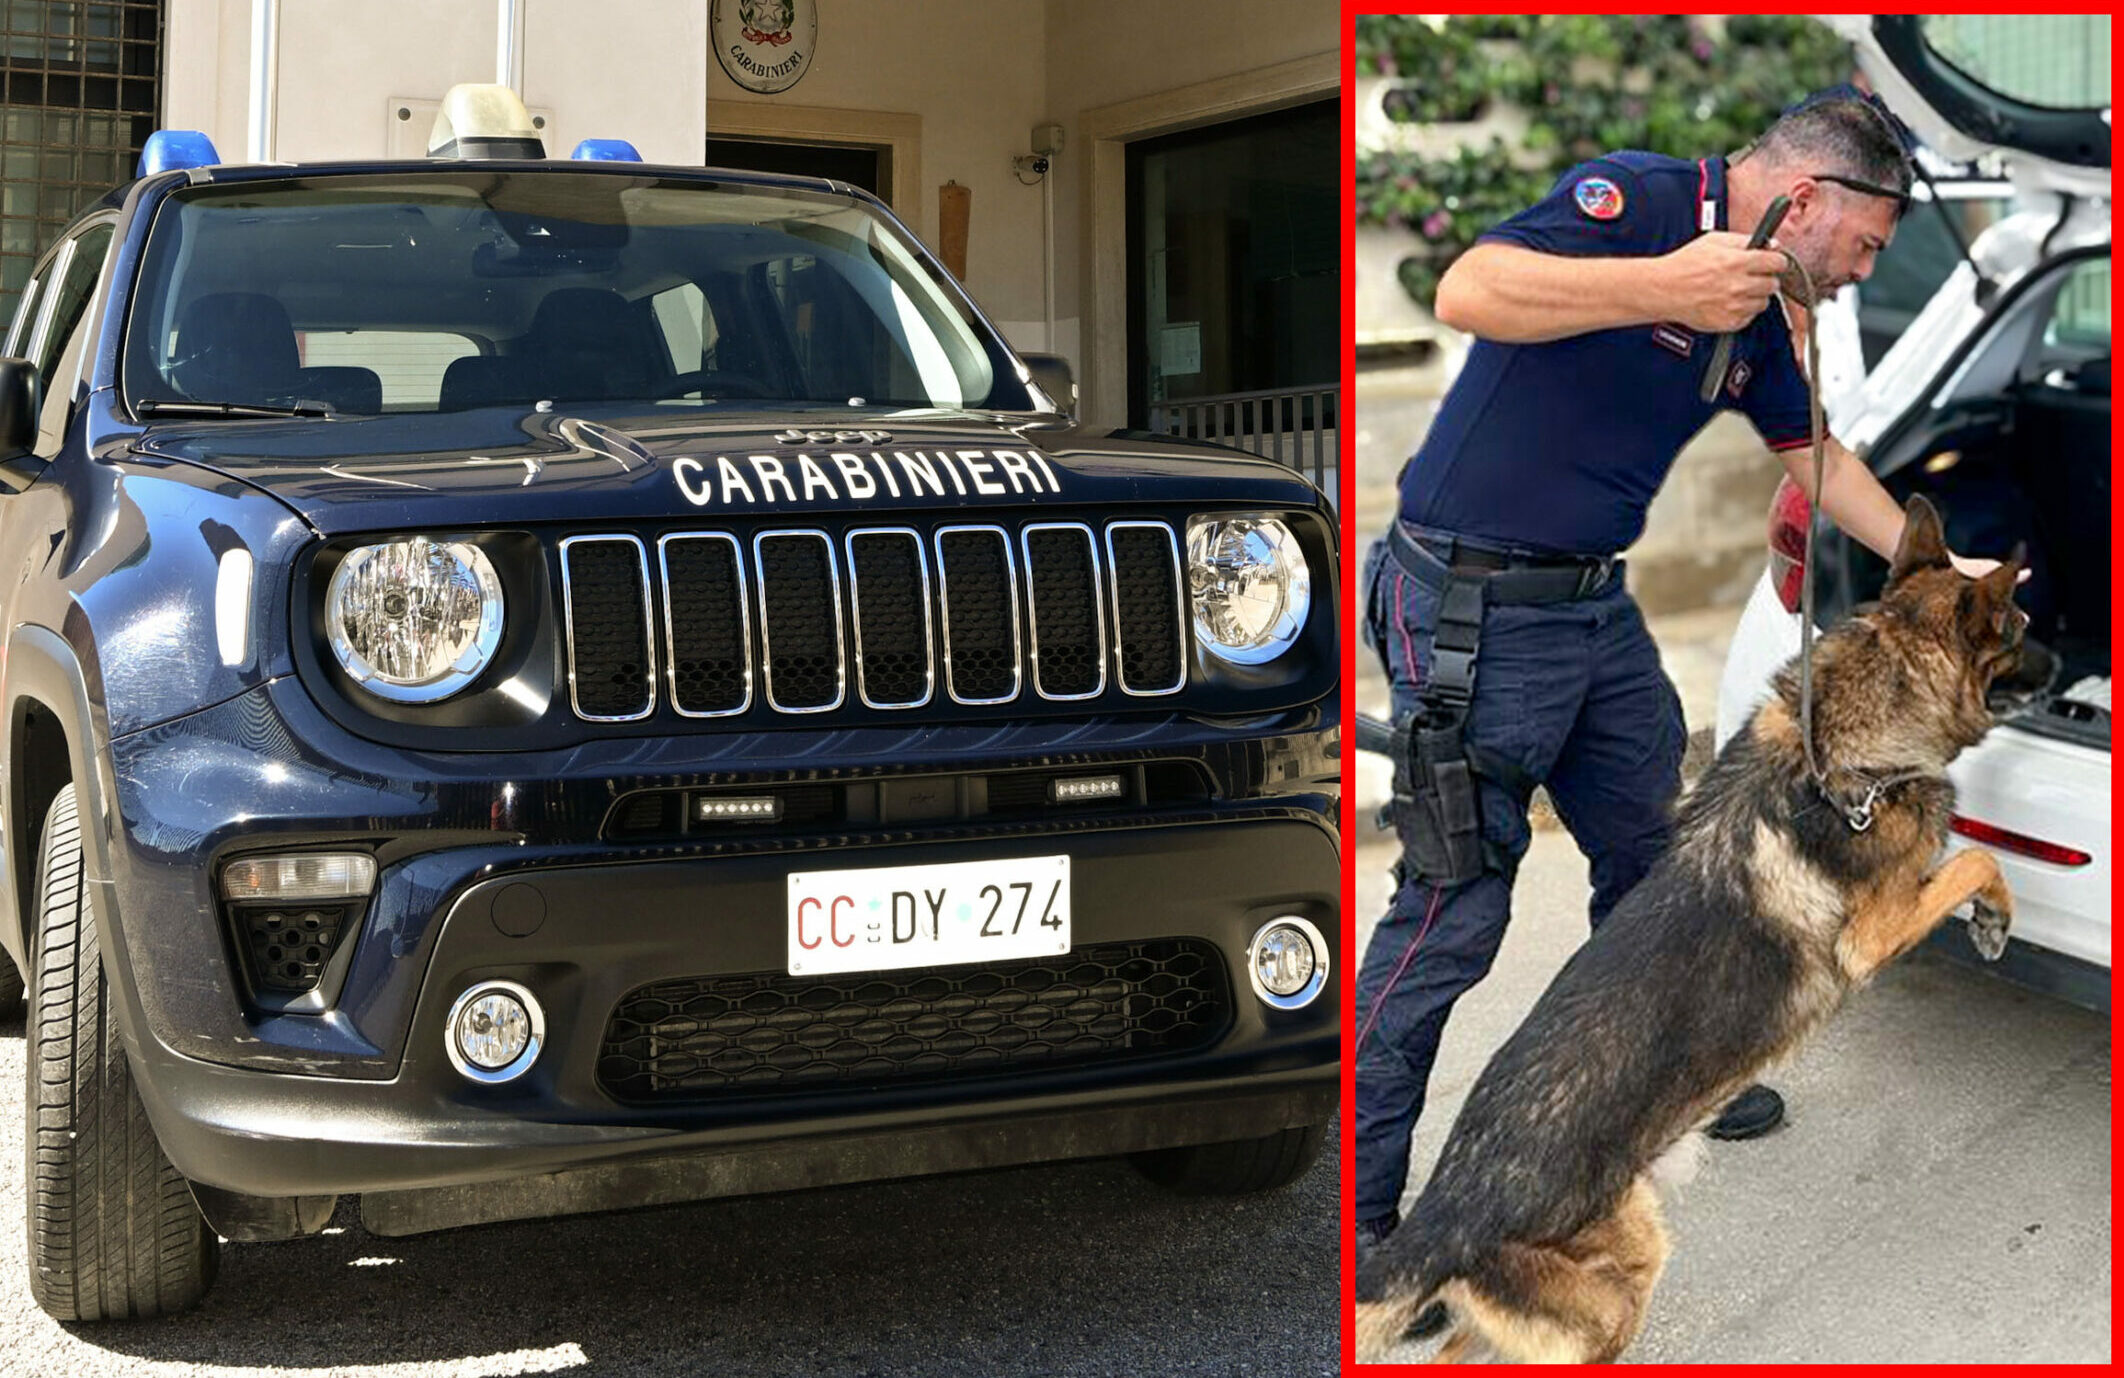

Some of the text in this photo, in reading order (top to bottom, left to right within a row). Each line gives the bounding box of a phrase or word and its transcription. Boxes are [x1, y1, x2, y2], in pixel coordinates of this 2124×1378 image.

[730, 45, 803, 78] CARABINIERI
[774, 429, 893, 446] Jeep
[672, 450, 1060, 506] CARABINIERI
[797, 879, 1063, 950] CC DY 274
